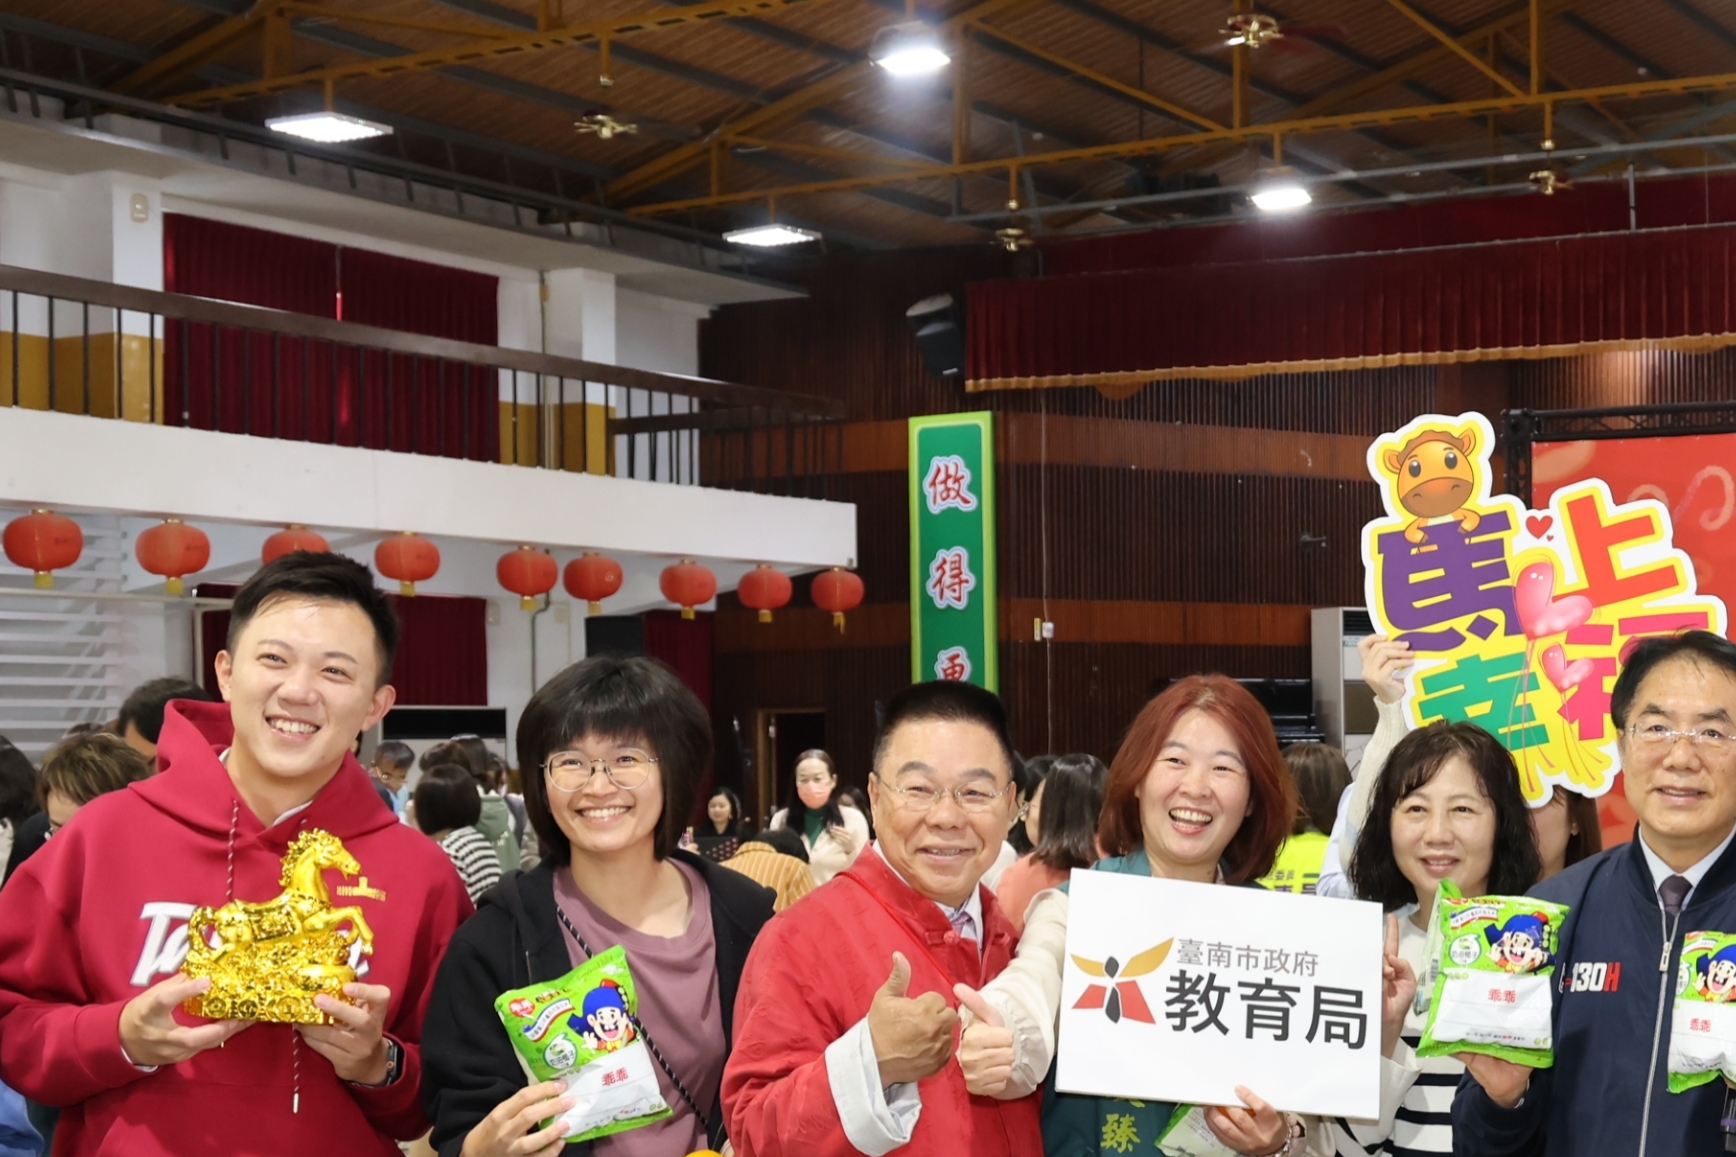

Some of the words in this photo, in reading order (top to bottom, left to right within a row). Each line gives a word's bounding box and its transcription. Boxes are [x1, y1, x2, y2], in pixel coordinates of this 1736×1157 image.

[1377, 494, 1680, 652] 馬上
[1177, 937, 1320, 978] 臺南市政府
[1164, 968, 1368, 1050] 教育局
[1488, 988, 1517, 1004] 乖乖
[1689, 1017, 1712, 1033] 乖乖
[602, 1066, 629, 1087] 乖乖
